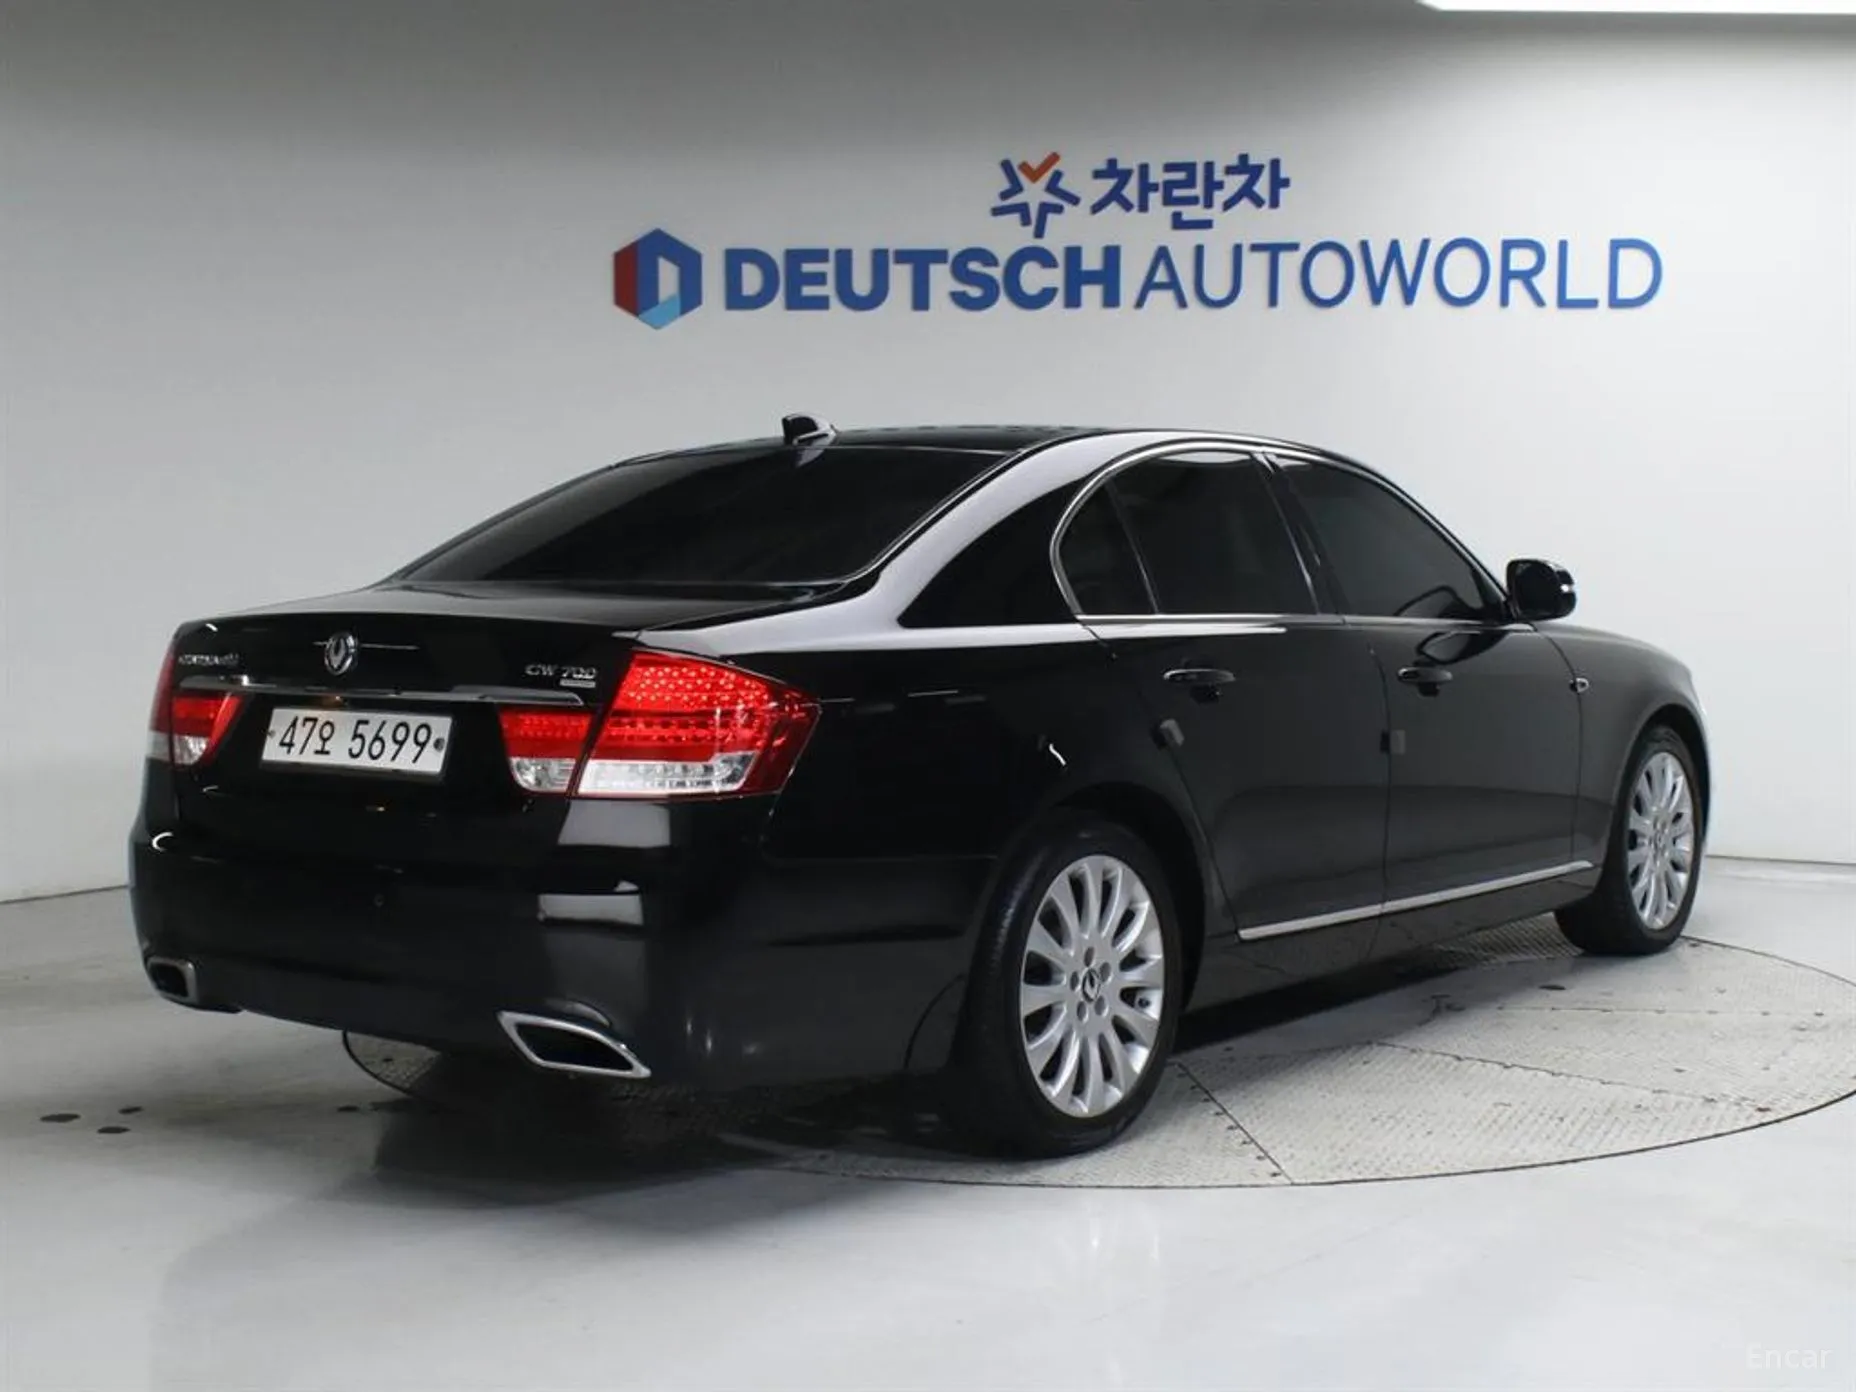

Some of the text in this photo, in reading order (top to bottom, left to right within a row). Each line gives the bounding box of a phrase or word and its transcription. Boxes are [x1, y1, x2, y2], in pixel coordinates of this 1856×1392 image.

[1090, 152, 1291, 230] 차란차
[724, 236, 1665, 312] DEUTSCH AUTOWORLD
[279, 716, 432, 764] 47오 5699
